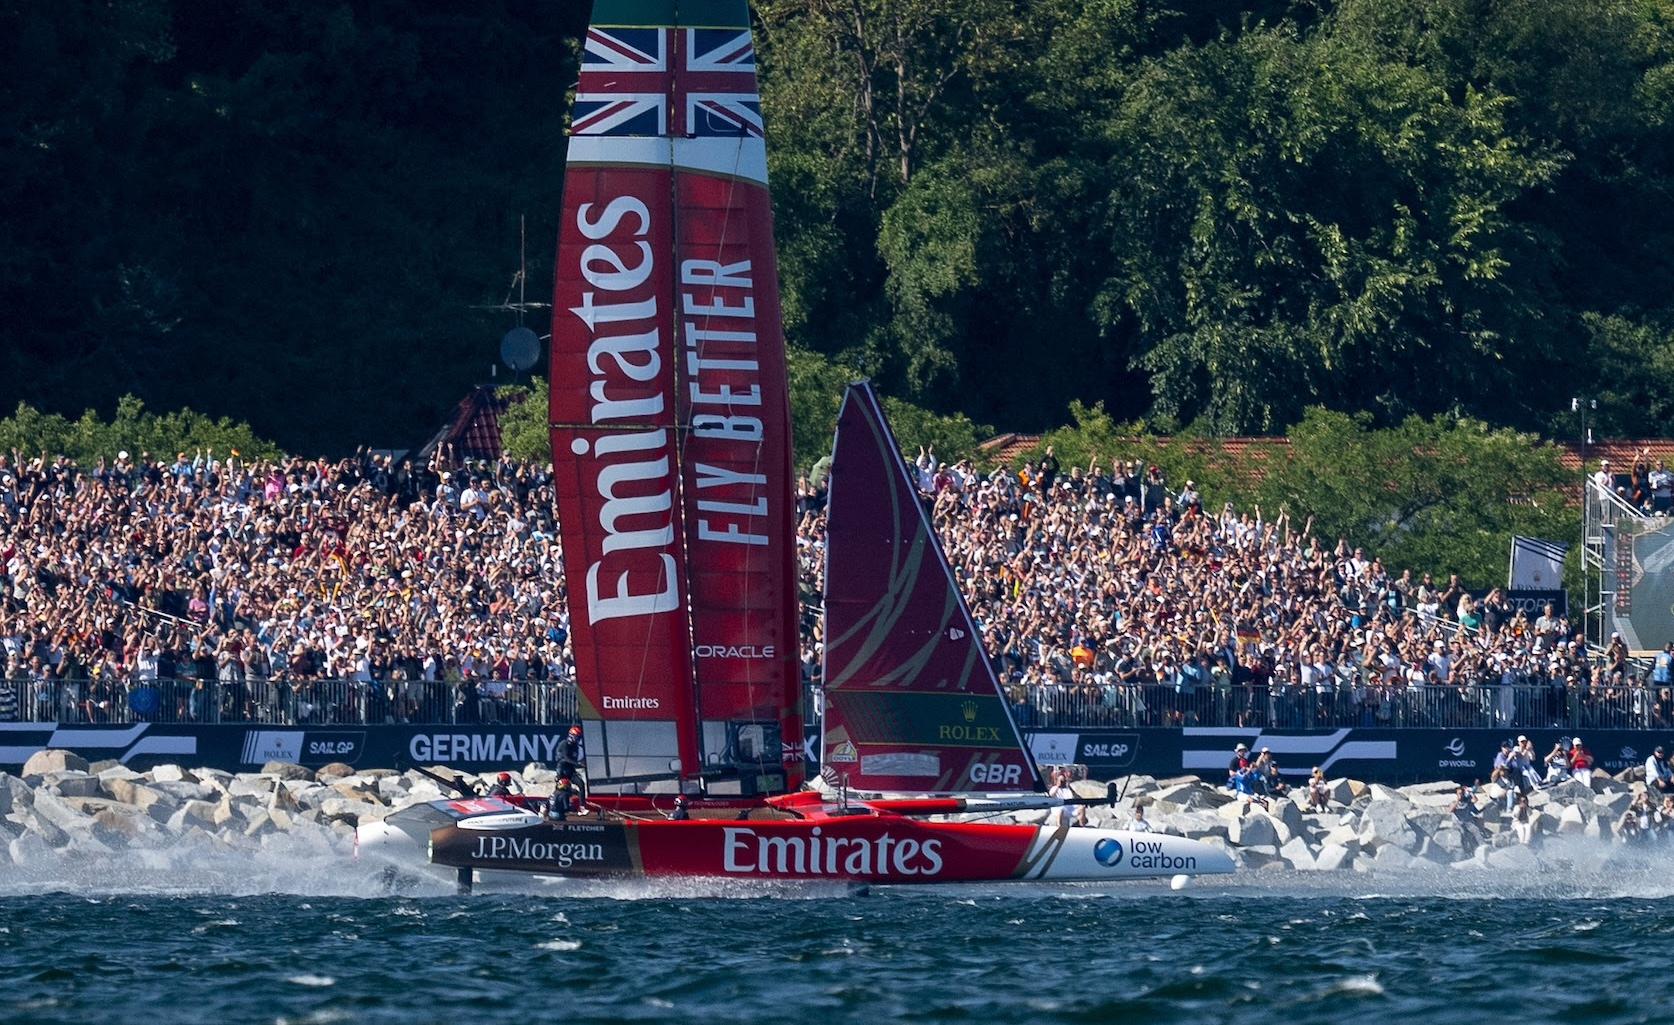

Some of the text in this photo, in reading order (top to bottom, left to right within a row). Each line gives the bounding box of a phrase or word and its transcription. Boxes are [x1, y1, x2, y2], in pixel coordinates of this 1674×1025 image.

[680, 258, 769, 546] FLY BETTER
[568, 195, 680, 626] Emirates
[695, 645, 775, 659] ORACLE
[602, 696, 660, 709] Emirates
[939, 726, 1001, 741] ROLEX
[263, 751, 293, 759] ROLEX
[409, 733, 561, 762] GERMANY
[1038, 752, 1067, 761] ROLEX
[1439, 759, 1476, 767] DP WORLD
[969, 762, 1022, 785] GBR
[568, 824, 605, 832] FLETCHER
[471, 836, 604, 868] J.P.Morgan
[722, 826, 943, 875] Emirates
[1130, 838, 1162, 854] low
[1130, 852, 1196, 870] carbon
